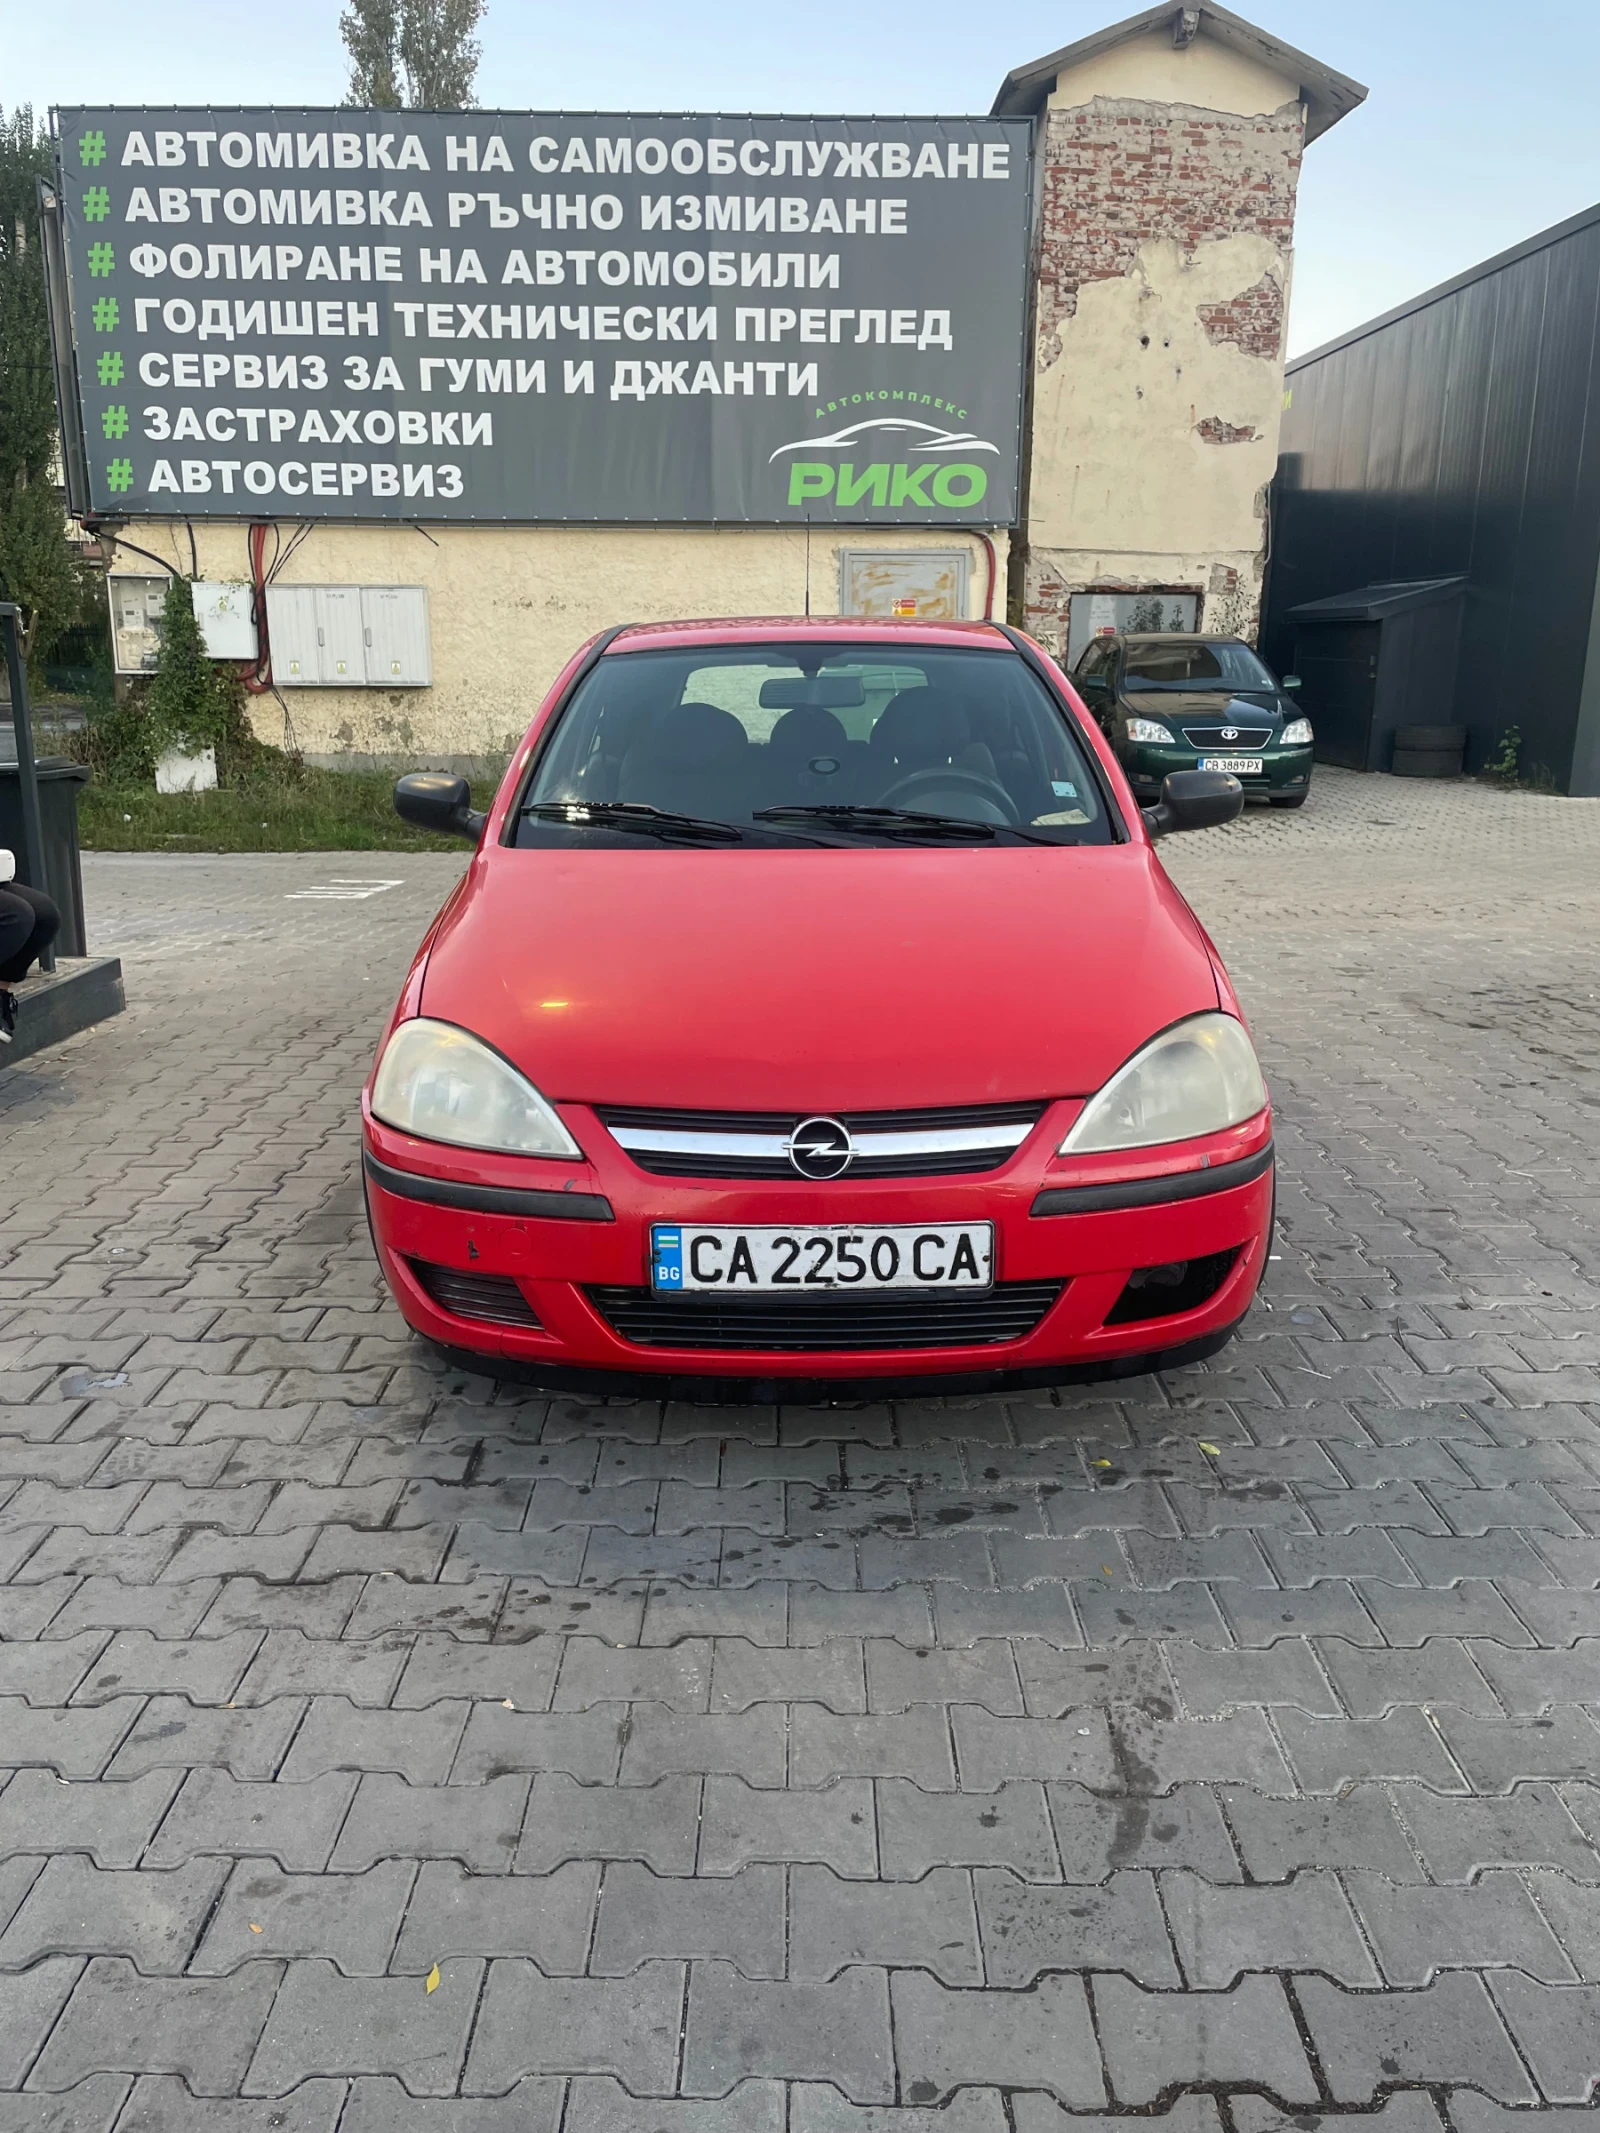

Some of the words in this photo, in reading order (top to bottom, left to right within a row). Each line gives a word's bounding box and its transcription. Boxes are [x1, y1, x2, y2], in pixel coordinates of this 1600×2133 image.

[78, 131, 107, 167] #
[120, 131, 431, 171] АВТОМИВКА
[445, 135, 515, 172] НА
[529, 136, 1010, 180] САМООБСЛУЖВАНЕ
[82, 185, 111, 223] #
[124, 187, 434, 228] АВТОМИВКА
[448, 192, 624, 231] РЪЧНО
[640, 195, 908, 234] ИЗМИВАНЕ
[87, 241, 116, 278] #
[129, 243, 403, 282] ФОЛИРАНЕ
[419, 247, 488, 284] НА
[501, 249, 840, 289] АВТОМОБИЛИ
[91, 296, 120, 333] #
[134, 298, 379, 341] ГОДИШЕН
[393, 302, 718, 342] ТЕХНИЧЕСКИ
[735, 306, 953, 351] ПРЕГЛЕД
[95, 351, 125, 387] #
[138, 352, 329, 390] СЕРВИЗ
[343, 355, 406, 391] ЗА
[419, 357, 547, 394] ГУМИ
[563, 360, 595, 394] И
[610, 360, 818, 402] ДЖАНТИ
[101, 404, 130, 440] #
[142, 405, 494, 447] ЗАСТРАХОВКИ
[815, 390, 969, 420] АВТОКОМПЛЕКС
[105, 457, 135, 493] #
[147, 459, 464, 498] АВТОСЕРВИЗ
[787, 462, 988, 508] РИКО
[1205, 760, 1219, 771] CB
[1220, 760, 1246, 771] 3889
[1246, 760, 1261, 771] PX
[658, 1266, 680, 1281] BG
[690, 1235, 758, 1284] CA
[771, 1235, 900, 1284] 2250
[913, 1233, 980, 1281] CA
